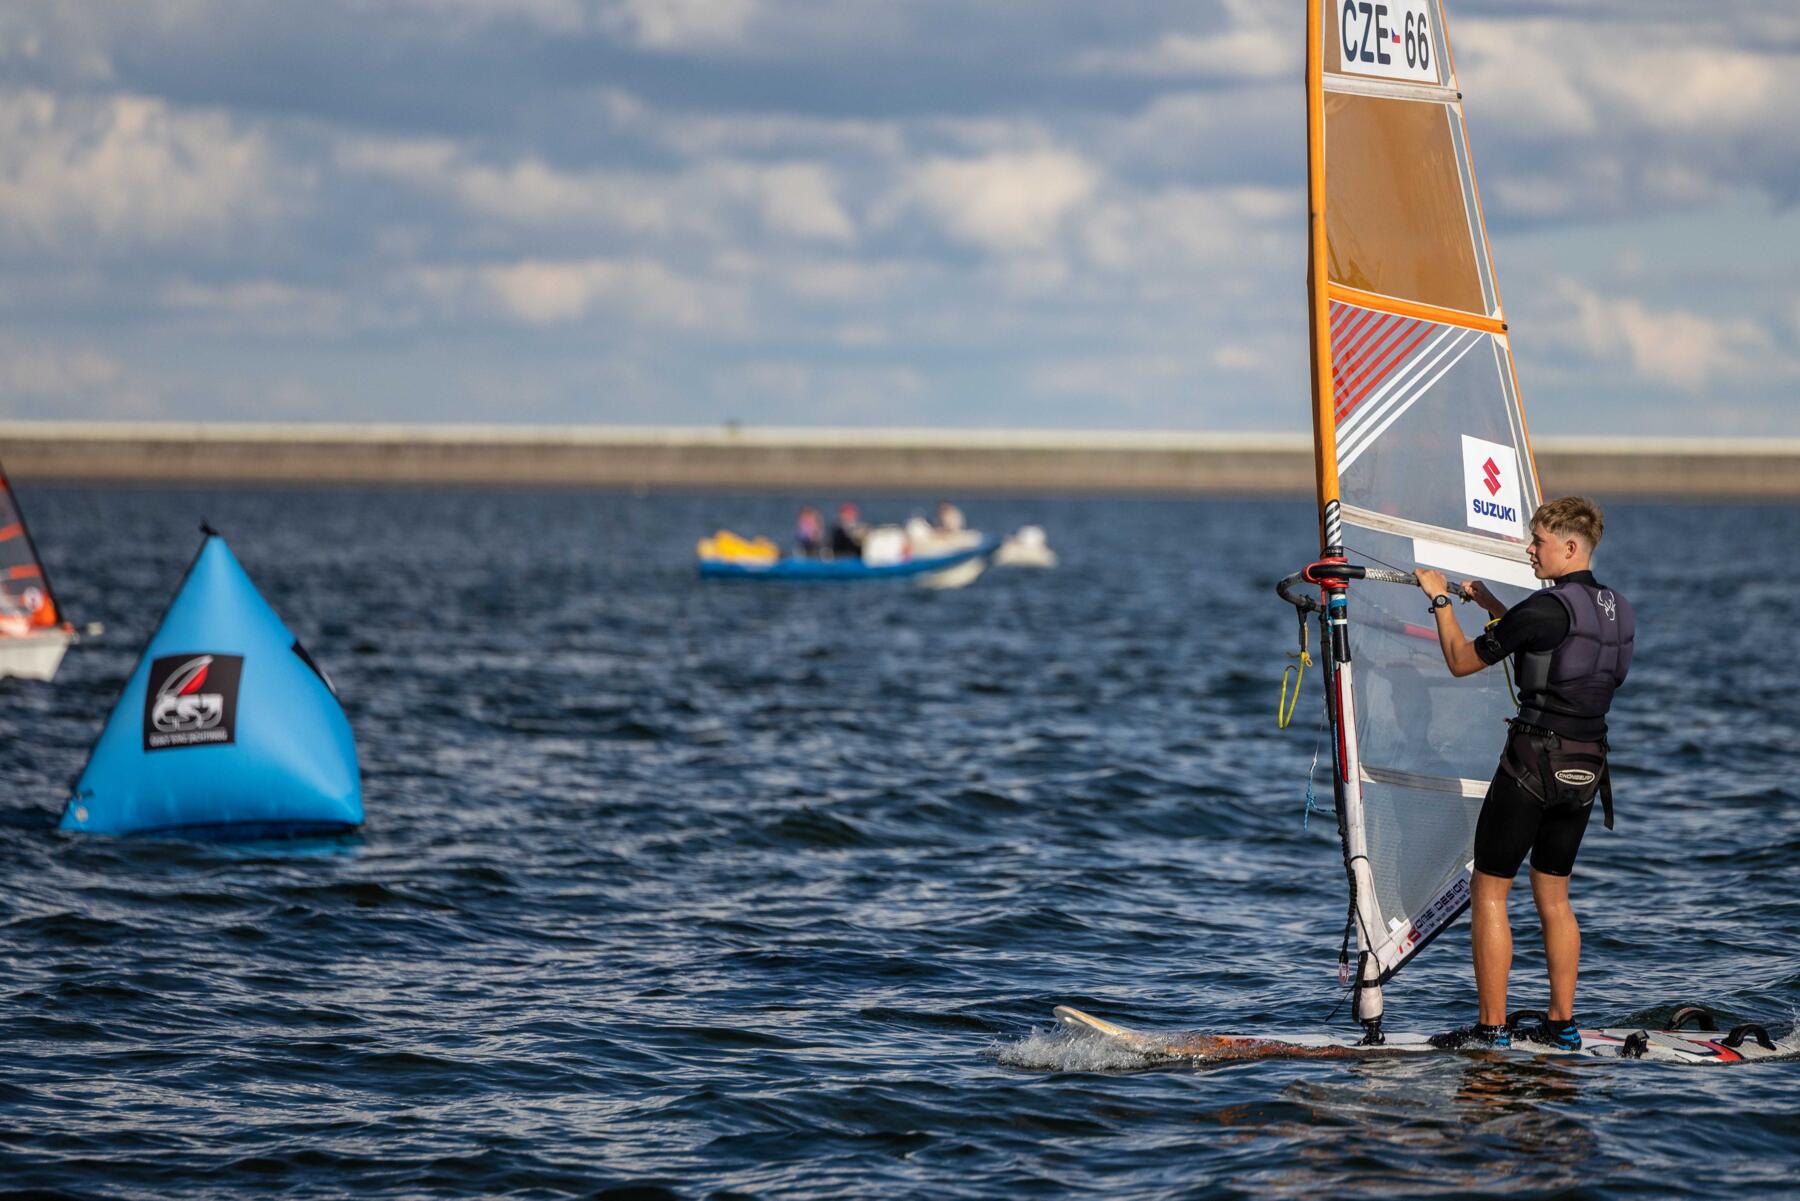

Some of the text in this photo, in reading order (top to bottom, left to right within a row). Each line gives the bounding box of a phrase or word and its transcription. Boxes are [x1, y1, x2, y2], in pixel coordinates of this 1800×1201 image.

[1342, 0, 1429, 70] CZE 66
[1473, 498, 1516, 522] SUZUKI
[1415, 908, 1435, 929] ONE
